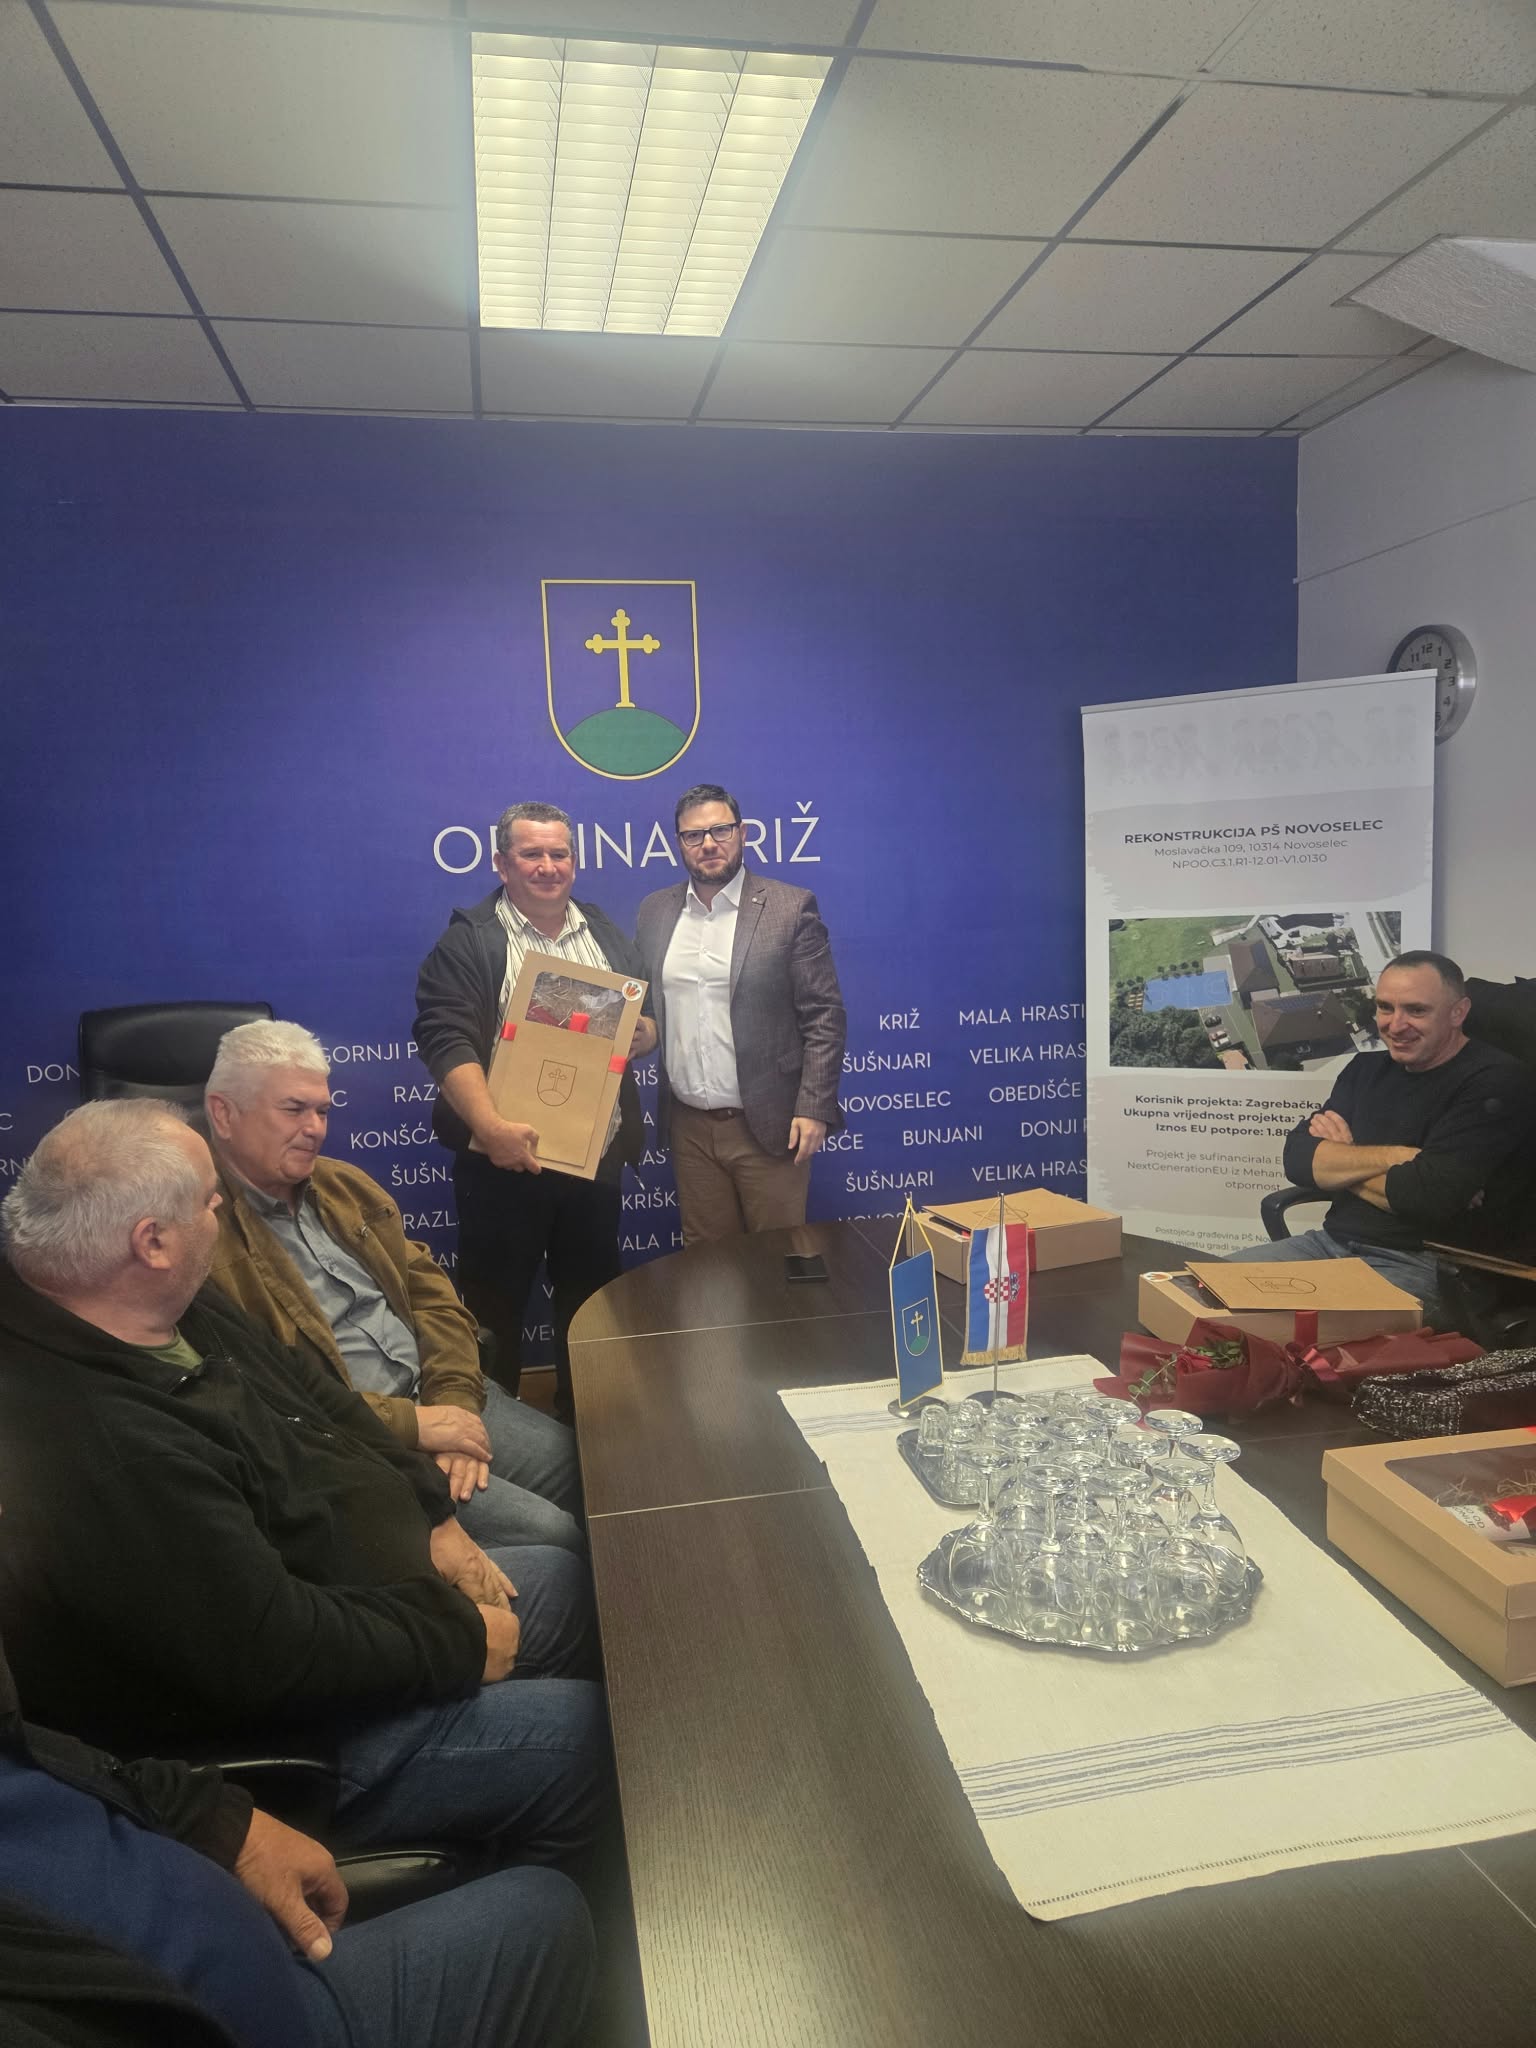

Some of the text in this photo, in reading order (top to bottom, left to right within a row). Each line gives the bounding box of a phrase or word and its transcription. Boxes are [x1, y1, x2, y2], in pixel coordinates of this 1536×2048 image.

[1422, 643, 1432, 655] 12
[1444, 658, 1452, 669] 2
[1448, 676, 1455, 687] 3
[434, 801, 821, 873] OINA RIŽ
[1124, 819, 1383, 844] REKONSTRUKCIJA PŠ NOVOSELEC
[1154, 839, 1348, 857] Moslavačka 109, 10314 Novoselec
[879, 1008, 921, 1031] KRIŽ
[959, 1007, 1012, 1026] MALA
[842, 1050, 931, 1073] ŠUŠNJARI
[969, 1046, 1034, 1065] VELIKA
[393, 1083, 440, 1103] RAZ
[989, 1077, 1082, 1103] OBEDIŠĆE
[838, 1090, 952, 1113] NOVOSELEC
[1135, 1095, 1322, 1110] Korisnik projekta: Zagrebačka
[1123, 1108, 1170, 1119] Ukupna
[1173, 1110, 1234, 1121] vrijednost
[1238, 1113, 1295, 1124] projekta:
[903, 1125, 983, 1146] BUNJANI
[1020, 1119, 1077, 1137] DONJI
[1156, 1123, 1187, 1132] Iznos
[1190, 1125, 1207, 1133] EU
[1210, 1127, 1264, 1137] potpore:
[1146, 1149, 1184, 1160] Projekt
[1187, 1152, 1197, 1161] je
[1199, 1152, 1271, 1165] sufinancirala
[391, 1162, 454, 1186] ŠUŠN
[972, 1163, 1036, 1182] VELIKA
[1127, 1161, 1228, 1175] NextGenerationEU
[1231, 1167, 1240, 1175] iz
[846, 1169, 934, 1192] ŠUŠNJARI
[621, 1187, 681, 1211] KRIŠK
[402, 1210, 460, 1231] RAZL
[616, 1233, 660, 1252] ALA
